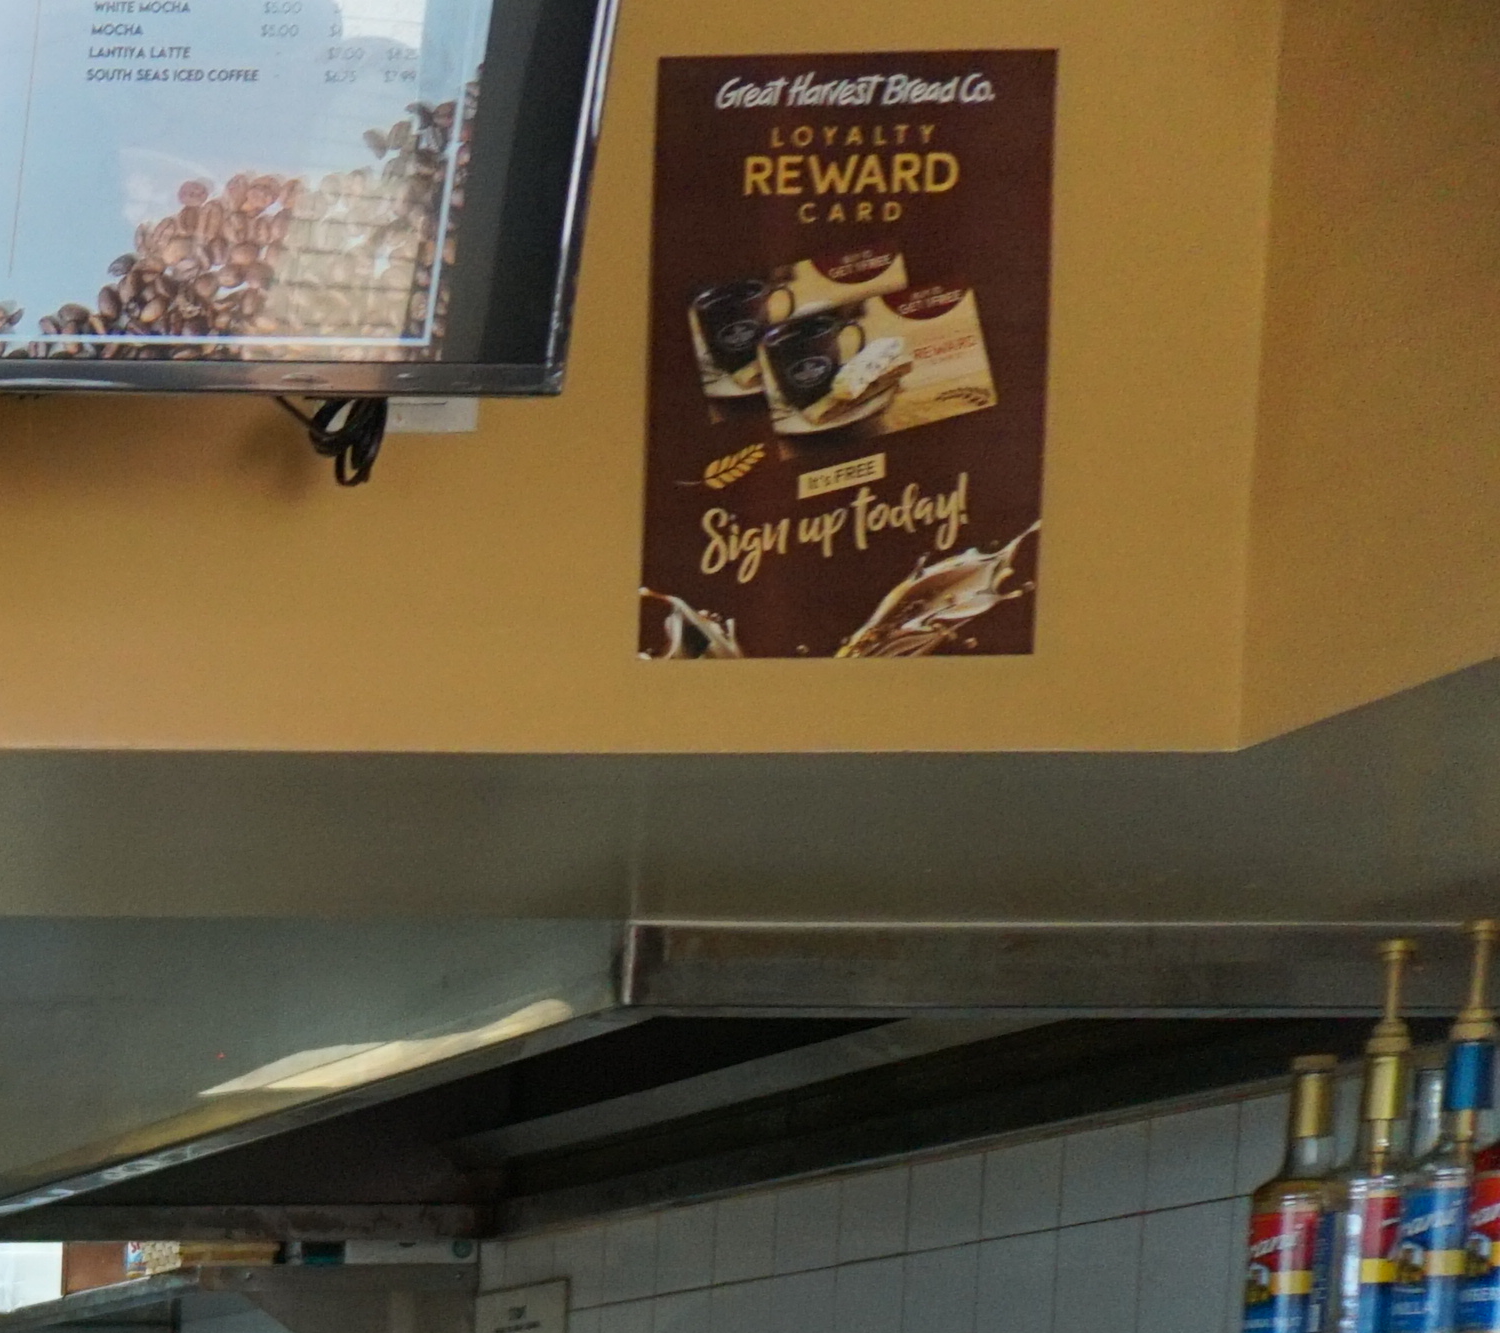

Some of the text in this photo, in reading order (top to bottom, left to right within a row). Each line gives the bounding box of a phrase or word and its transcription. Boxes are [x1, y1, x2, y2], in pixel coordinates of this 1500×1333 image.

[140, 0, 191, 13] MOCHA
[91, 24, 144, 37] MOCHA
[150, 46, 192, 60] LATTE
[85, 68, 260, 82] SOUTH SEAS ICED COFFEE
[715, 72, 996, 110] Great Harvest Bread Co.
[771, 124, 937, 148] LOYALTY
[742, 151, 960, 198] REWARD
[799, 202, 903, 224] CARD
[807, 461, 878, 492] It's FREE
[701, 472, 969, 582] Sign up today!
